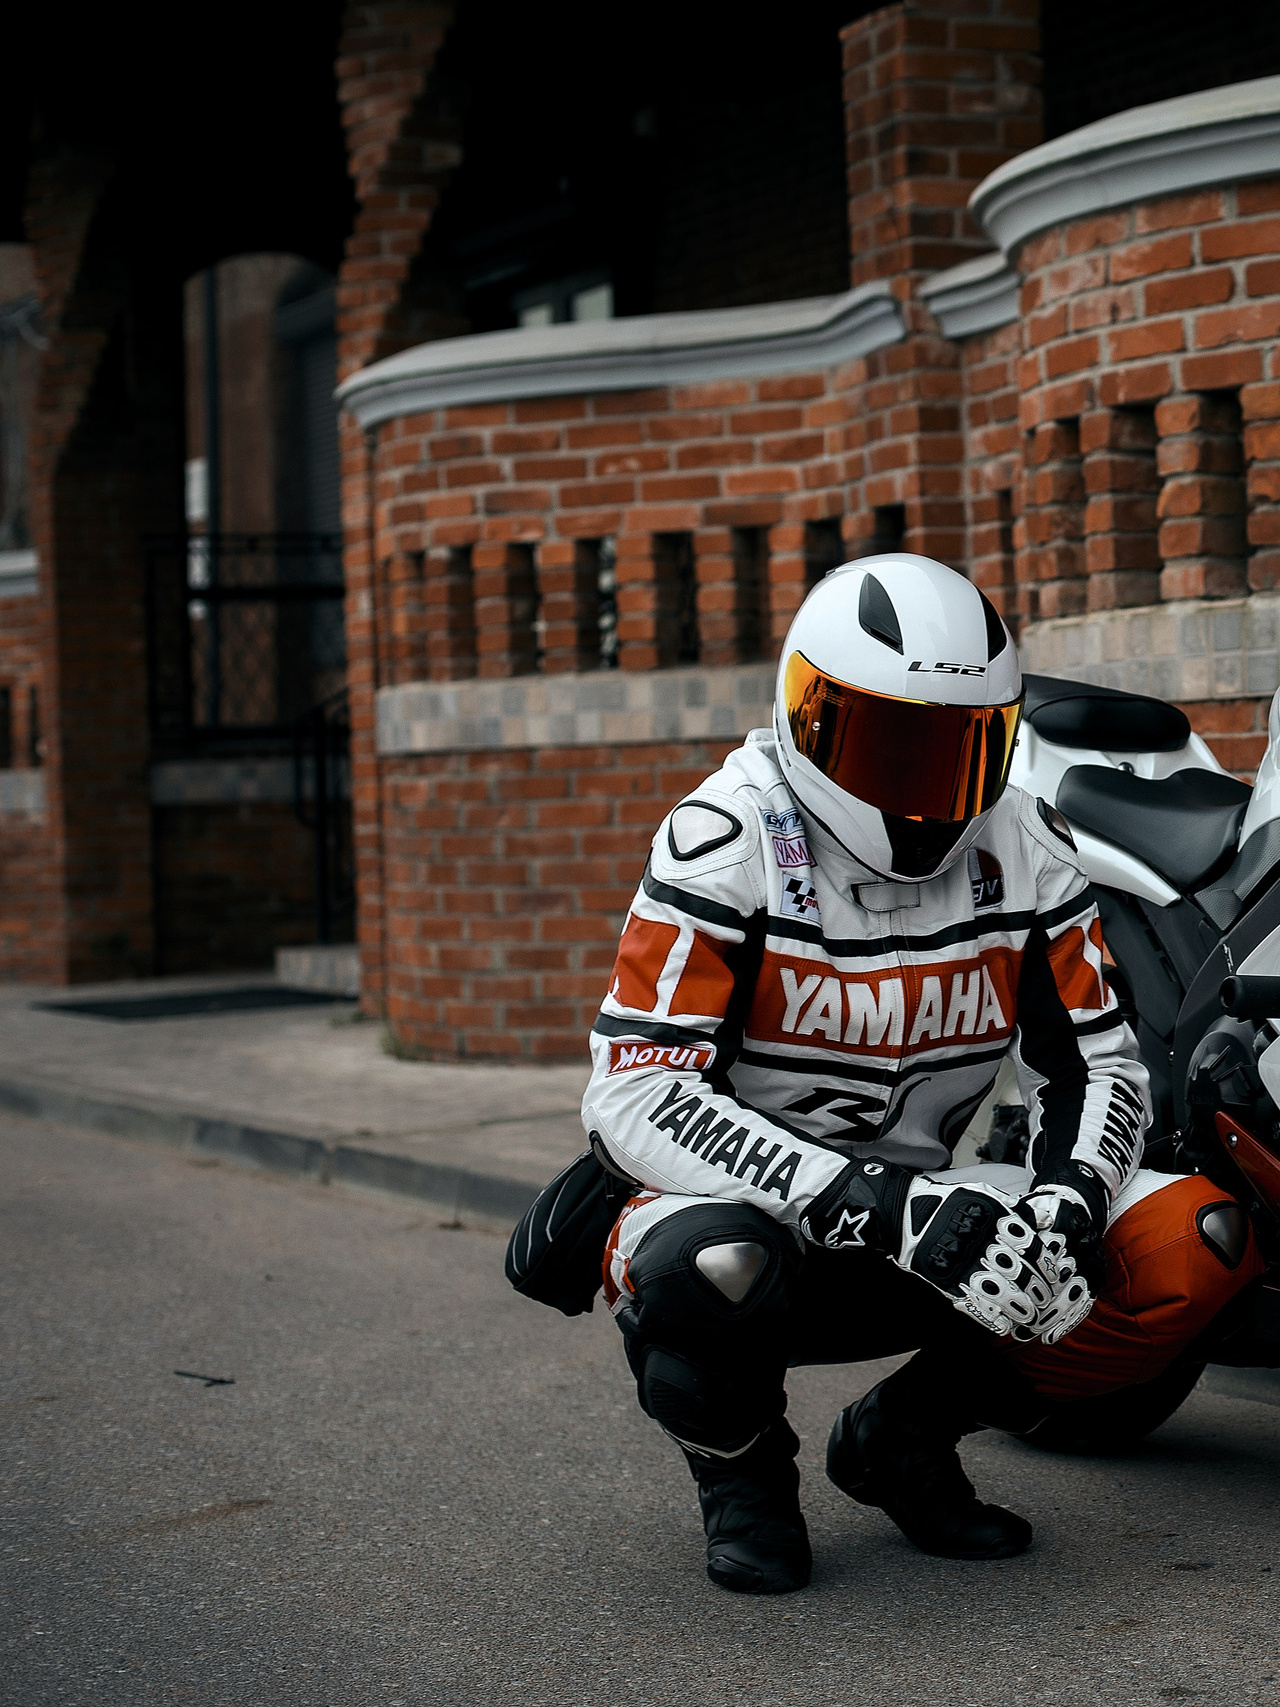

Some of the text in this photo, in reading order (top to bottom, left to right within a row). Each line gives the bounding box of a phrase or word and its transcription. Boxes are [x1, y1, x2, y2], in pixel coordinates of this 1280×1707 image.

[907, 661, 987, 678] LS2
[779, 964, 1008, 1046] YAMAHA
[612, 1046, 700, 1072] MOTUL
[648, 1080, 802, 1202] YAMAHA
